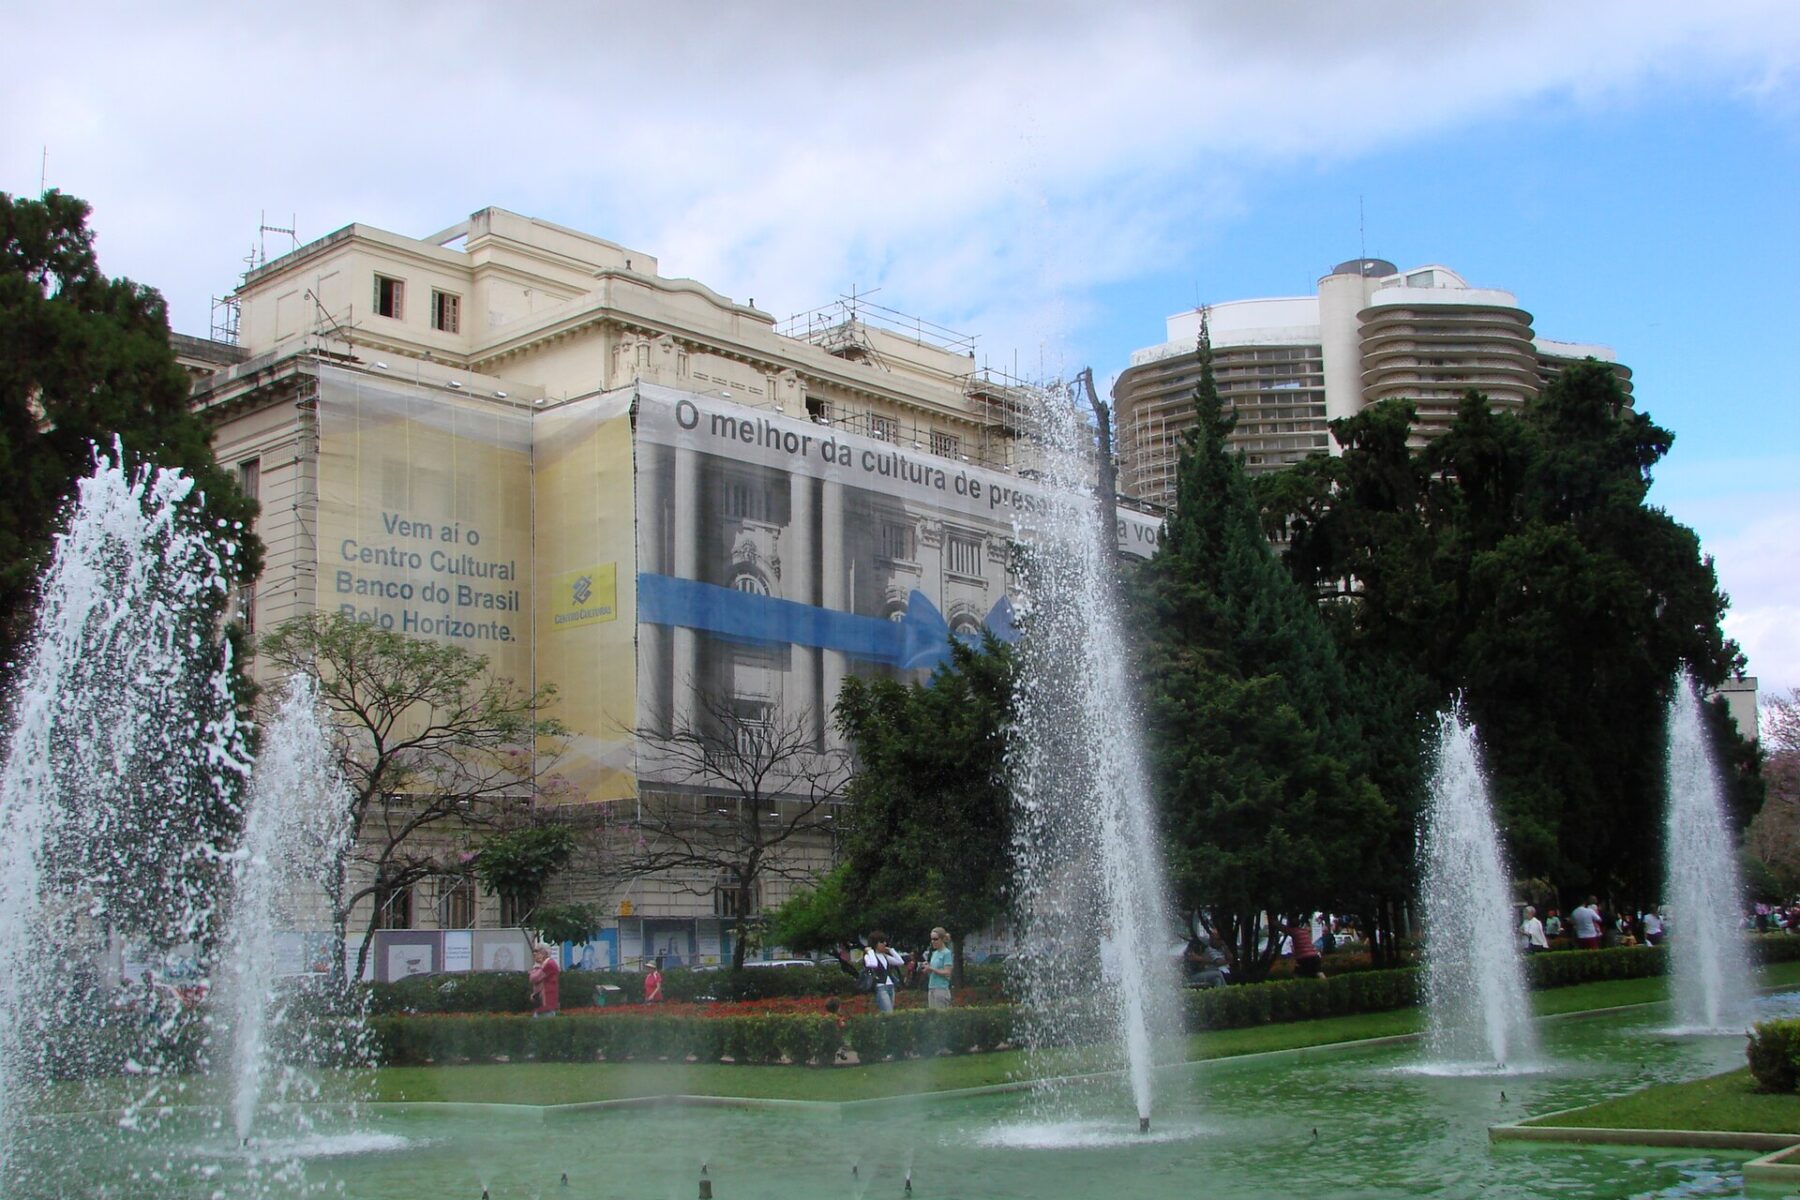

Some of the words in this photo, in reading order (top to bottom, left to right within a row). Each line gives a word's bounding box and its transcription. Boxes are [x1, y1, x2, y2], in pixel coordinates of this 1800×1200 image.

[675, 400, 699, 430] O
[711, 413, 812, 456] melhor
[821, 436, 852, 467] da
[861, 450, 946, 490] cultura
[954, 470, 981, 499] de
[382, 512, 433, 540] Vem
[440, 522, 459, 544] aí
[466, 530, 480, 546] o
[341, 539, 422, 569] Centro
[430, 550, 515, 581] Cultural
[336, 570, 414, 600] Banco
[421, 582, 449, 604] do
[457, 585, 519, 611] Brasil
[340, 603, 395, 630] Belo
[403, 609, 516, 642] Horizonte.
